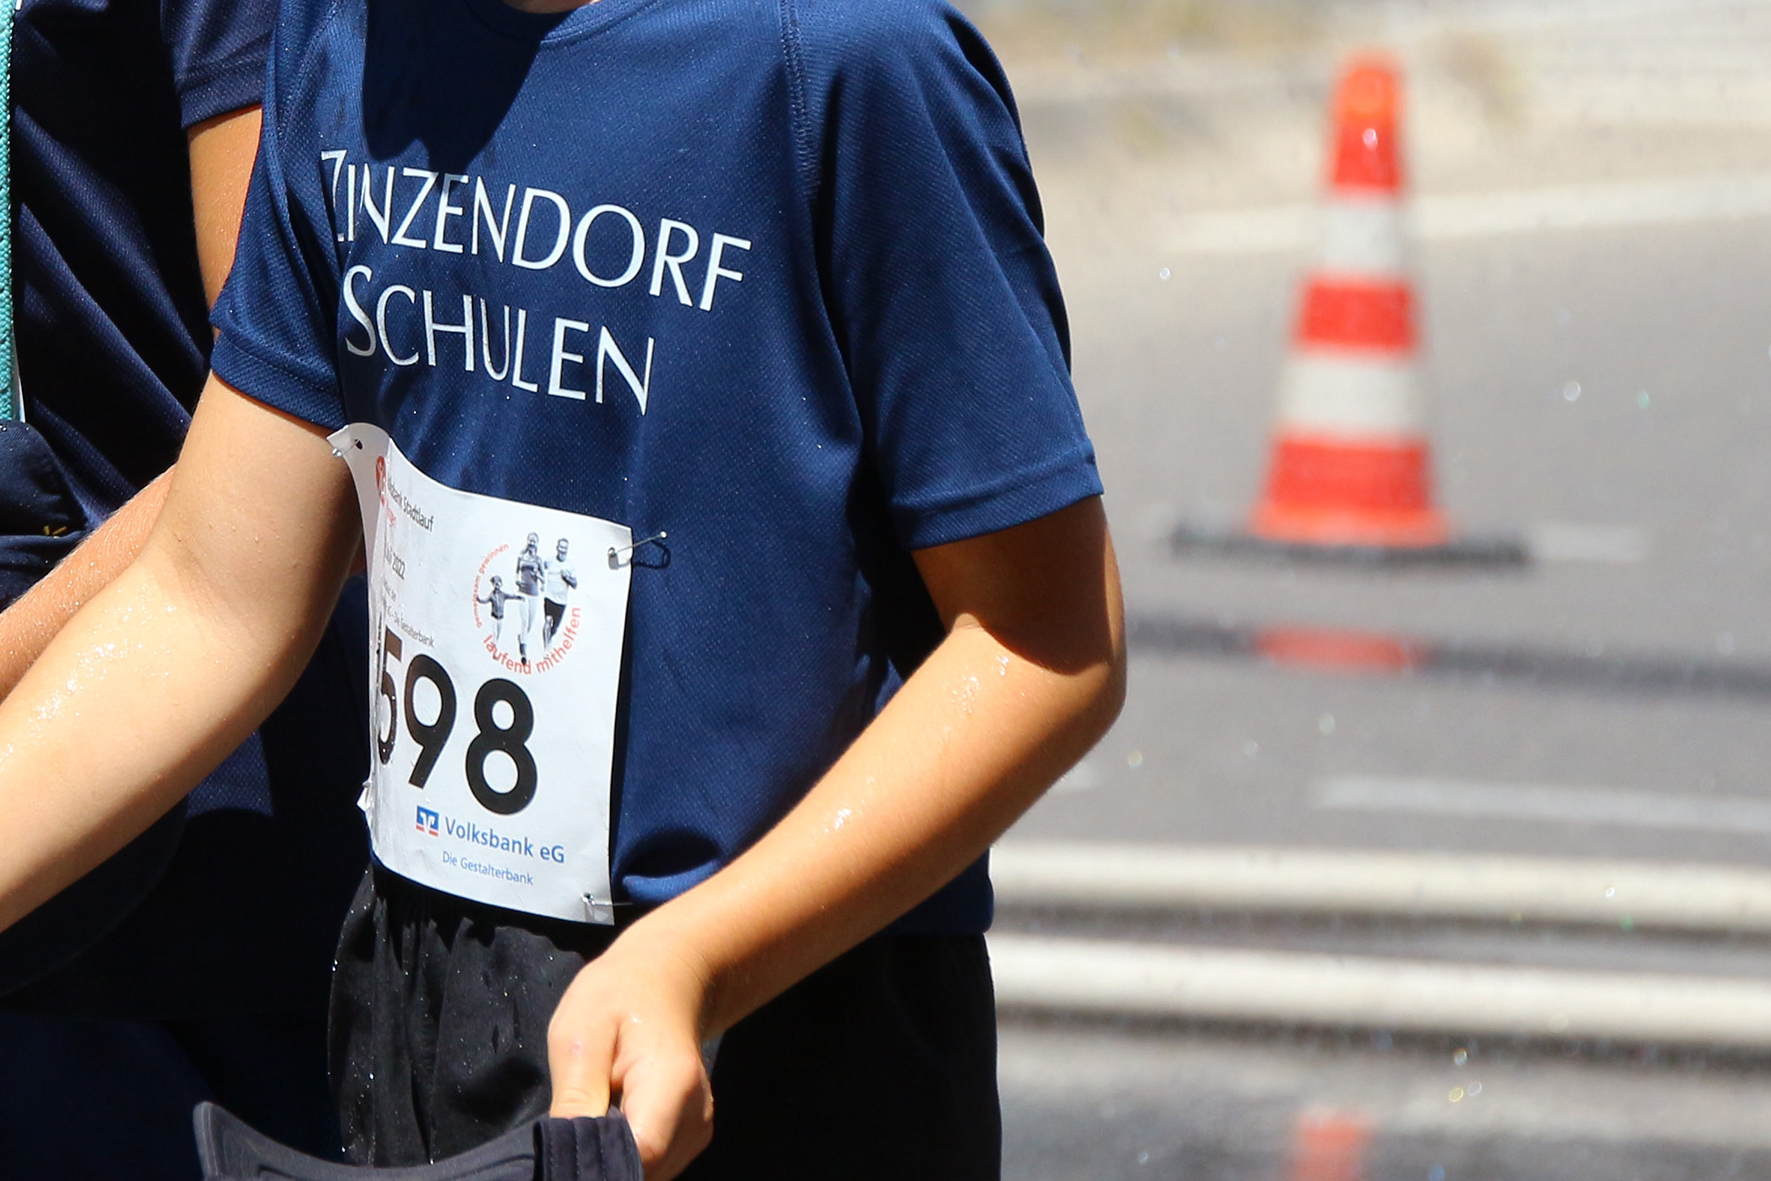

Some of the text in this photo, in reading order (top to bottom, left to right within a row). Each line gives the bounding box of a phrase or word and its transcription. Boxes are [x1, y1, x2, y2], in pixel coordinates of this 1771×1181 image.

[320, 149, 753, 312] ZINZENDORF
[341, 263, 656, 416] SCHULEN
[478, 543, 510, 575] gewinnen
[483, 606, 582, 675] laufend mithelfen
[376, 623, 539, 817] 598
[441, 850, 535, 887] Die Gestalterbank
[444, 815, 566, 864] Volksbank eG
